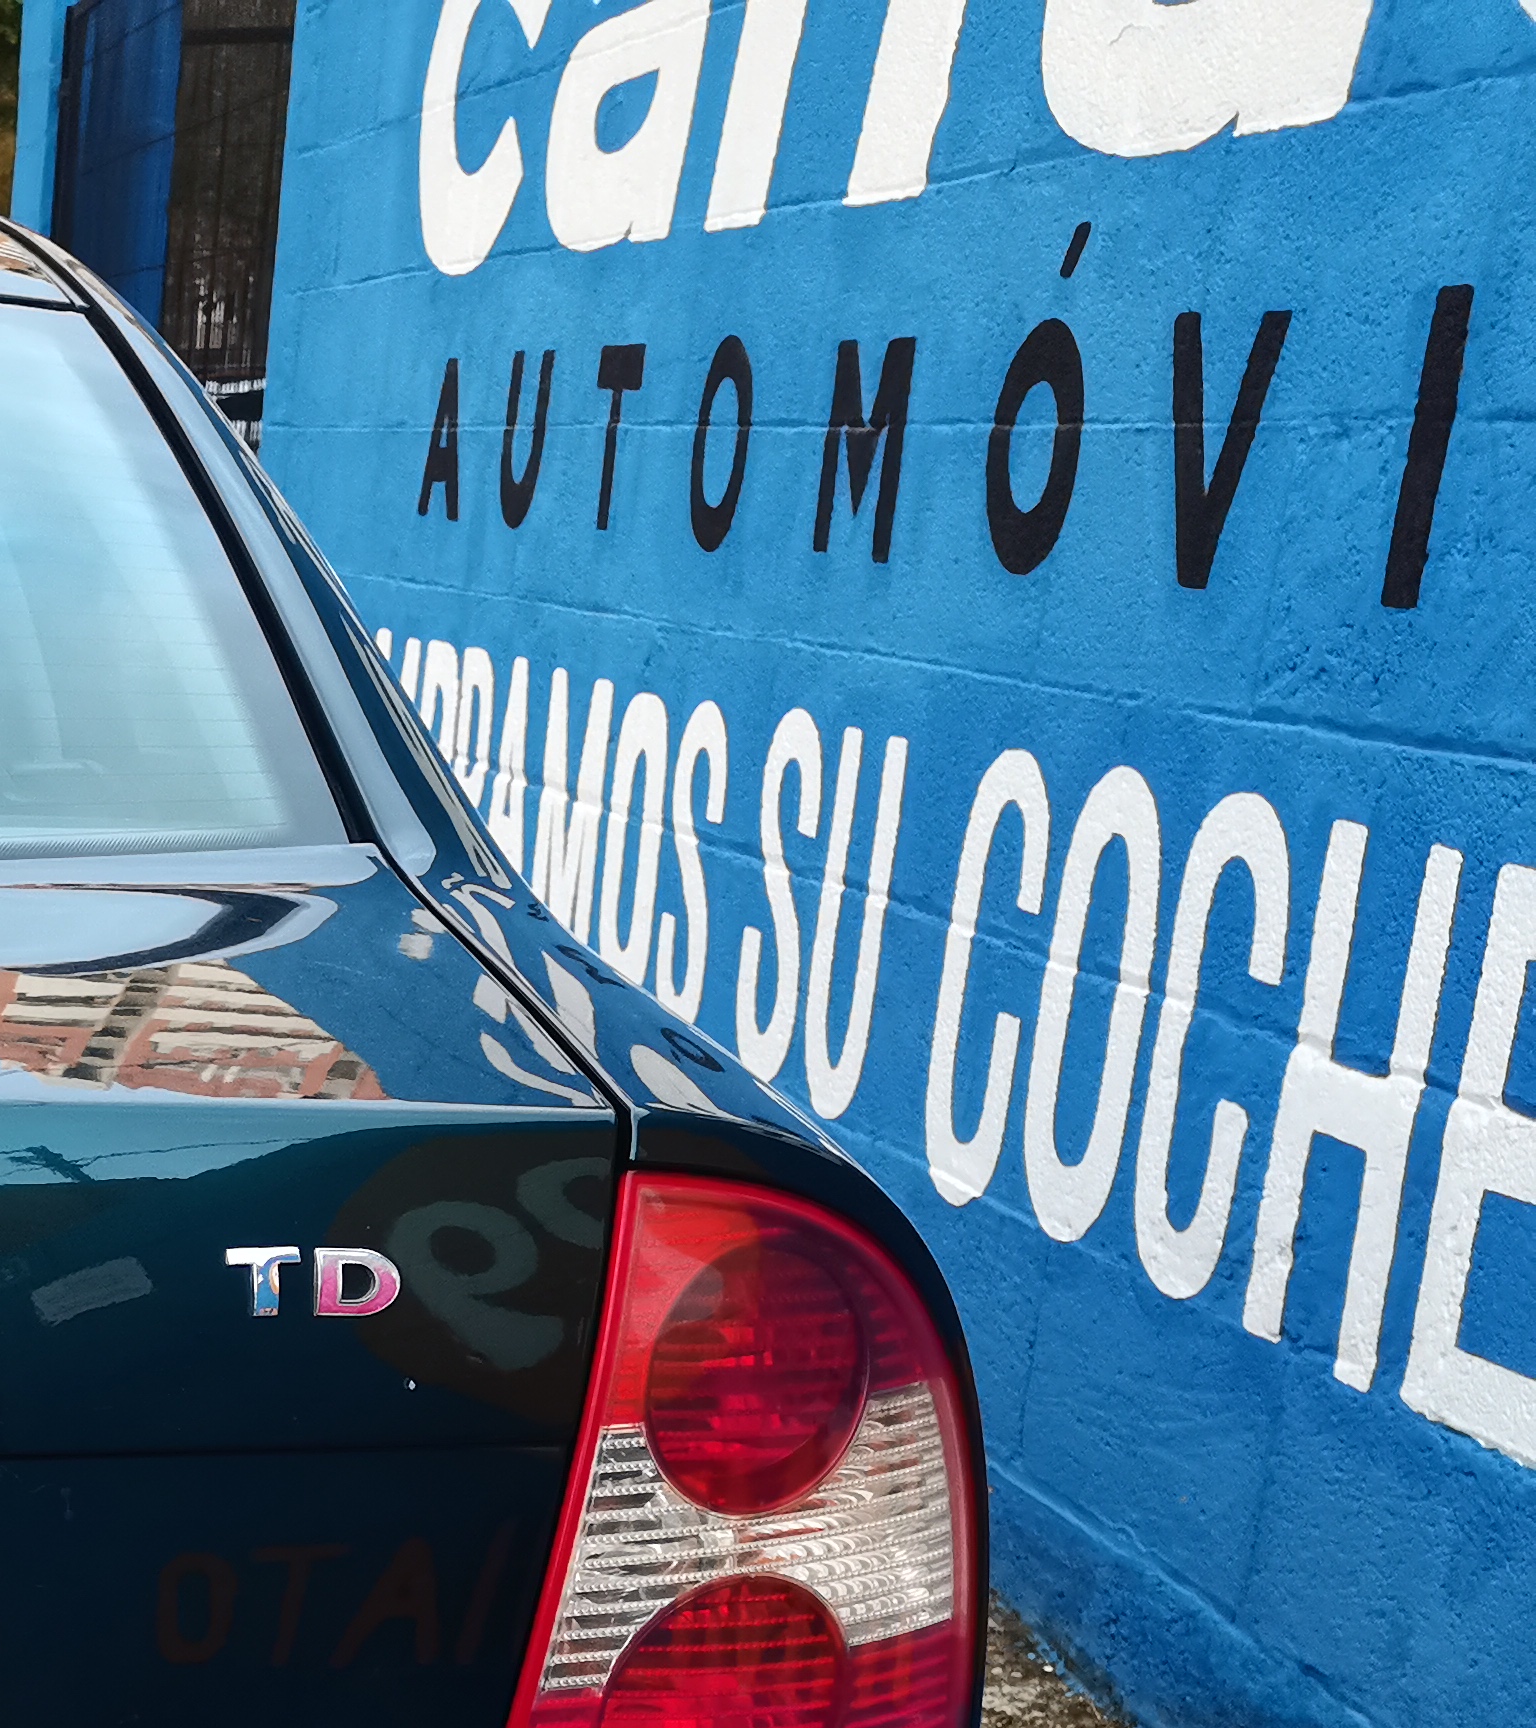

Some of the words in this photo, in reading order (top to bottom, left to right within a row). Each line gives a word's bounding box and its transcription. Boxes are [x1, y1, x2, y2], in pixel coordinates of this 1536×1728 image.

[418, 221, 1475, 614] AUTOMÓVI
[225, 1246, 402, 1317] TD
[736, 707, 909, 1120] SU
[926, 748, 1536, 1470] COCHE
